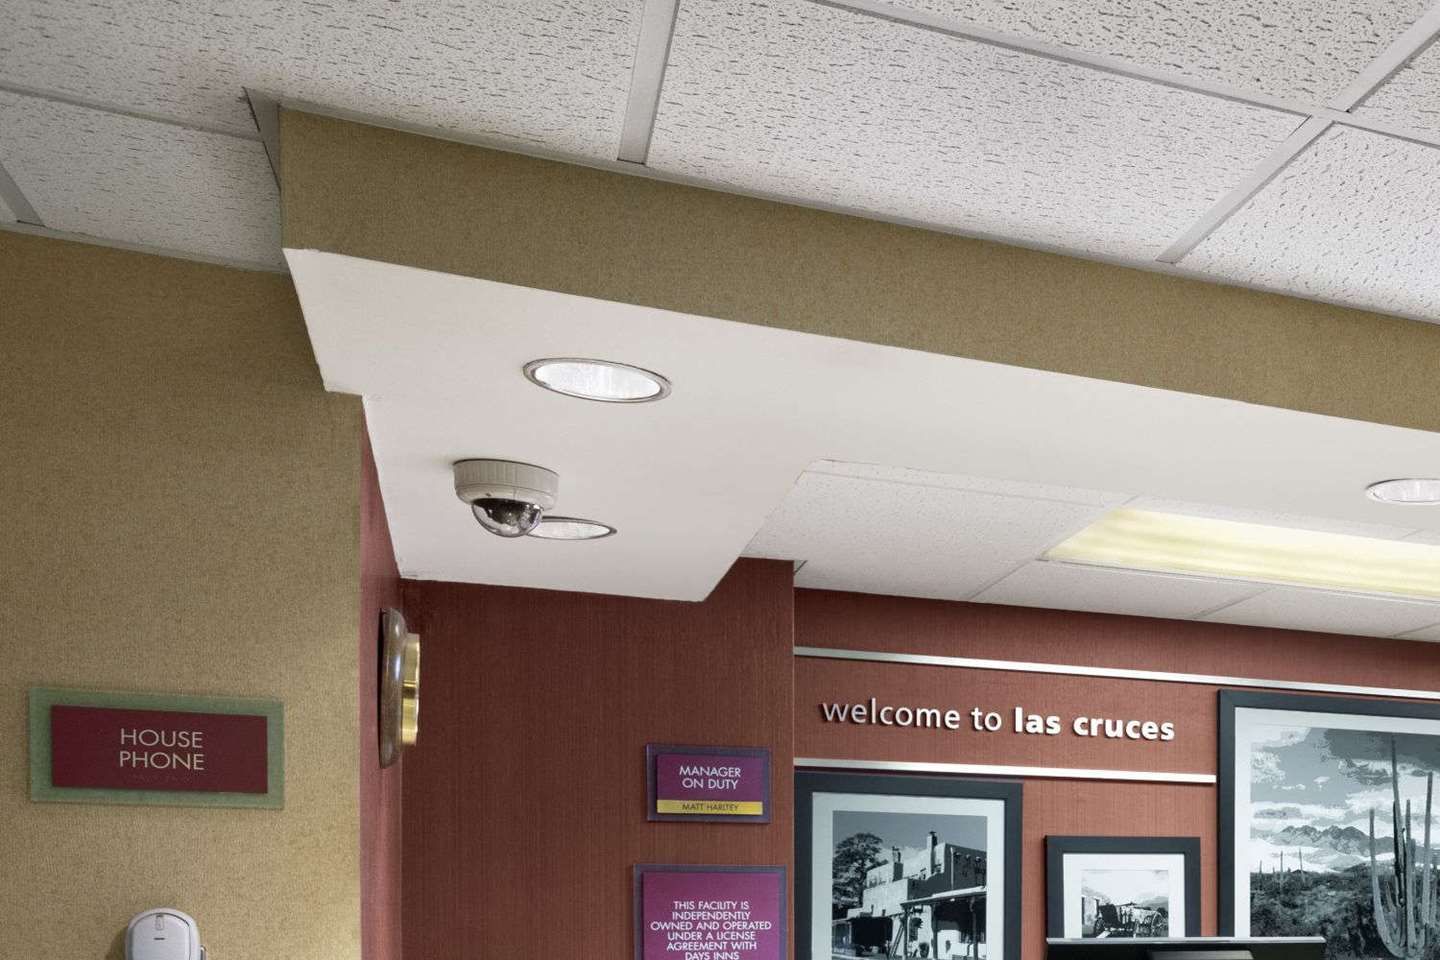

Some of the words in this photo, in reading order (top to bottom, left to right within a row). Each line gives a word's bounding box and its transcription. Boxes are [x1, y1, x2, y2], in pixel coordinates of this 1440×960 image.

[822, 697, 961, 731] welcome
[971, 705, 1002, 732] to
[1013, 706, 1062, 736] las
[1072, 714, 1176, 742] cruces
[120, 727, 204, 749] HOUSE
[119, 750, 205, 771] PHONE
[679, 765, 741, 778] MANAGER
[681, 777, 704, 789] ON
[707, 778, 739, 790] DUTY
[681, 803, 704, 812] MATT
[673, 900, 696, 911] THIS
[698, 900, 738, 911] FACILITY
[741, 901, 750, 911] IS
[671, 911, 751, 921] INDEPENDENTLY
[650, 921, 693, 931] OWNED
[696, 921, 720, 931] AND
[722, 921, 772, 931] OPERATED
[667, 931, 702, 941] UNDER
[705, 932, 714, 941] A
[717, 931, 756, 941] LICENSE
[666, 941, 727, 951] AGREEMENT
[731, 941, 758, 951] WITH
[684, 951, 710, 960] DAYS
[713, 951, 740, 960] INNS
